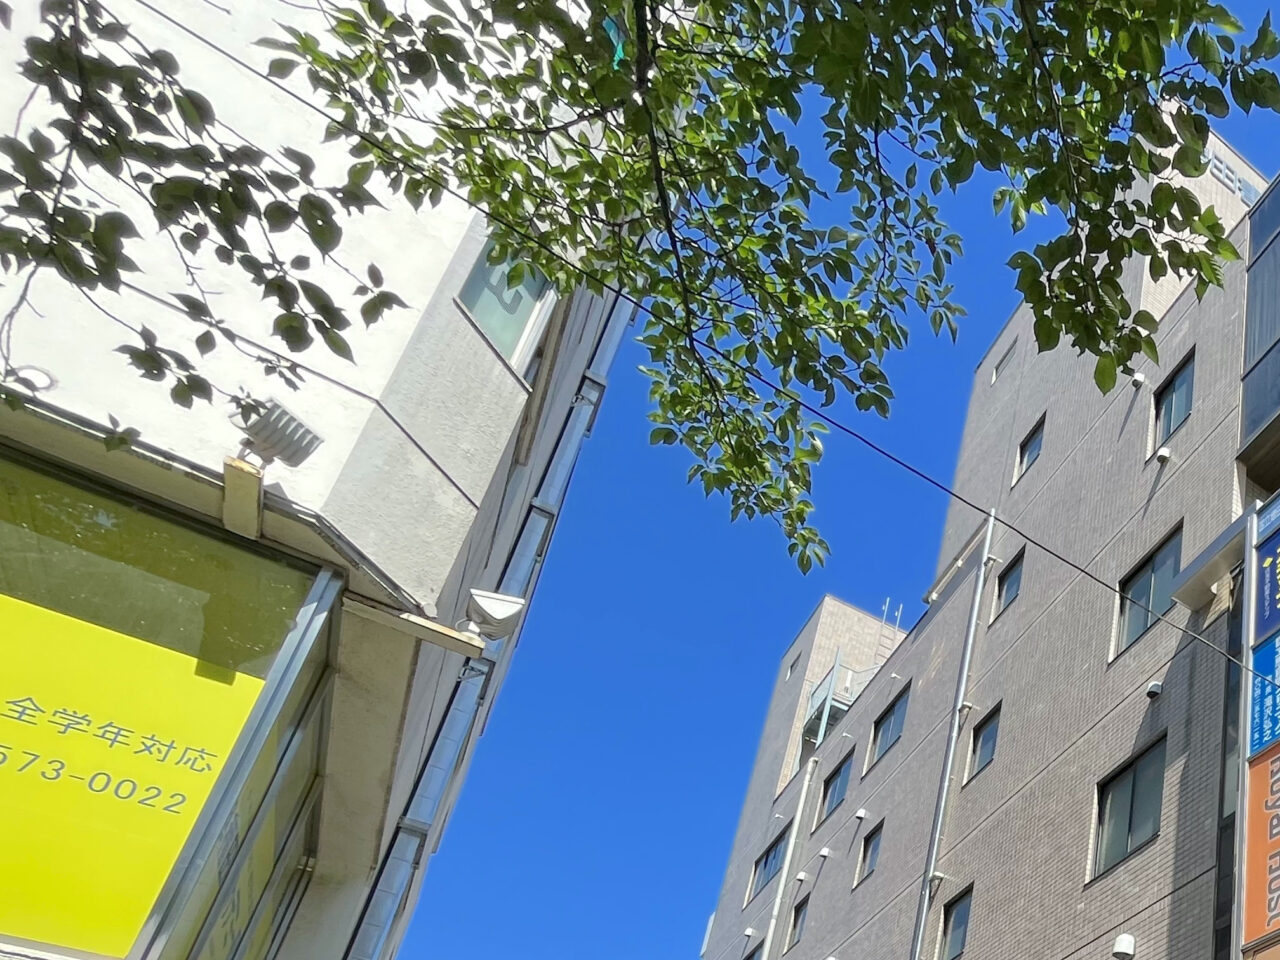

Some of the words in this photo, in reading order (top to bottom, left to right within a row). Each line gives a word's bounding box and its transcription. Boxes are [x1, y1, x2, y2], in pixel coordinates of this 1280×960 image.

[0, 696, 219, 773] 全学年対応
